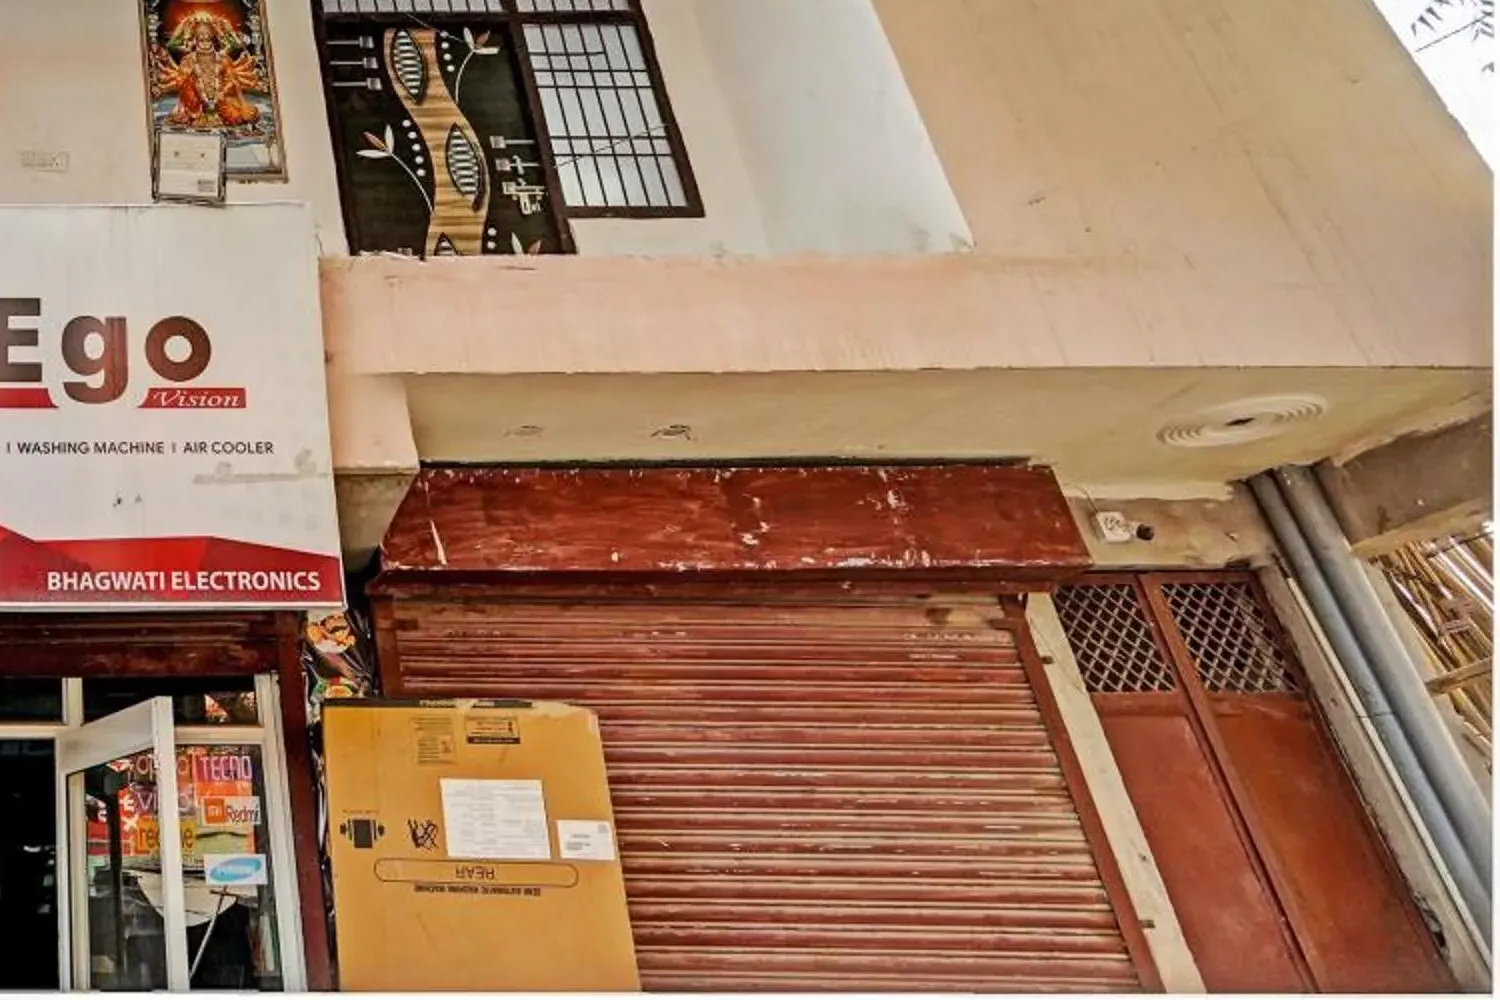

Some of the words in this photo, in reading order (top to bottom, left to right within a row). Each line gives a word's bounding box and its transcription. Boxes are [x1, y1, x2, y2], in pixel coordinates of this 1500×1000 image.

[151, 388, 241, 409] Vision
[16, 440, 91, 455] WASHING
[93, 440, 165, 455] MACHINE
[182, 440, 208, 455] AIR
[211, 441, 275, 455] COOLER
[46, 570, 167, 592] BHAGWATI
[170, 570, 321, 592] ELECTRONICS
[455, 864, 495, 880] REAR
